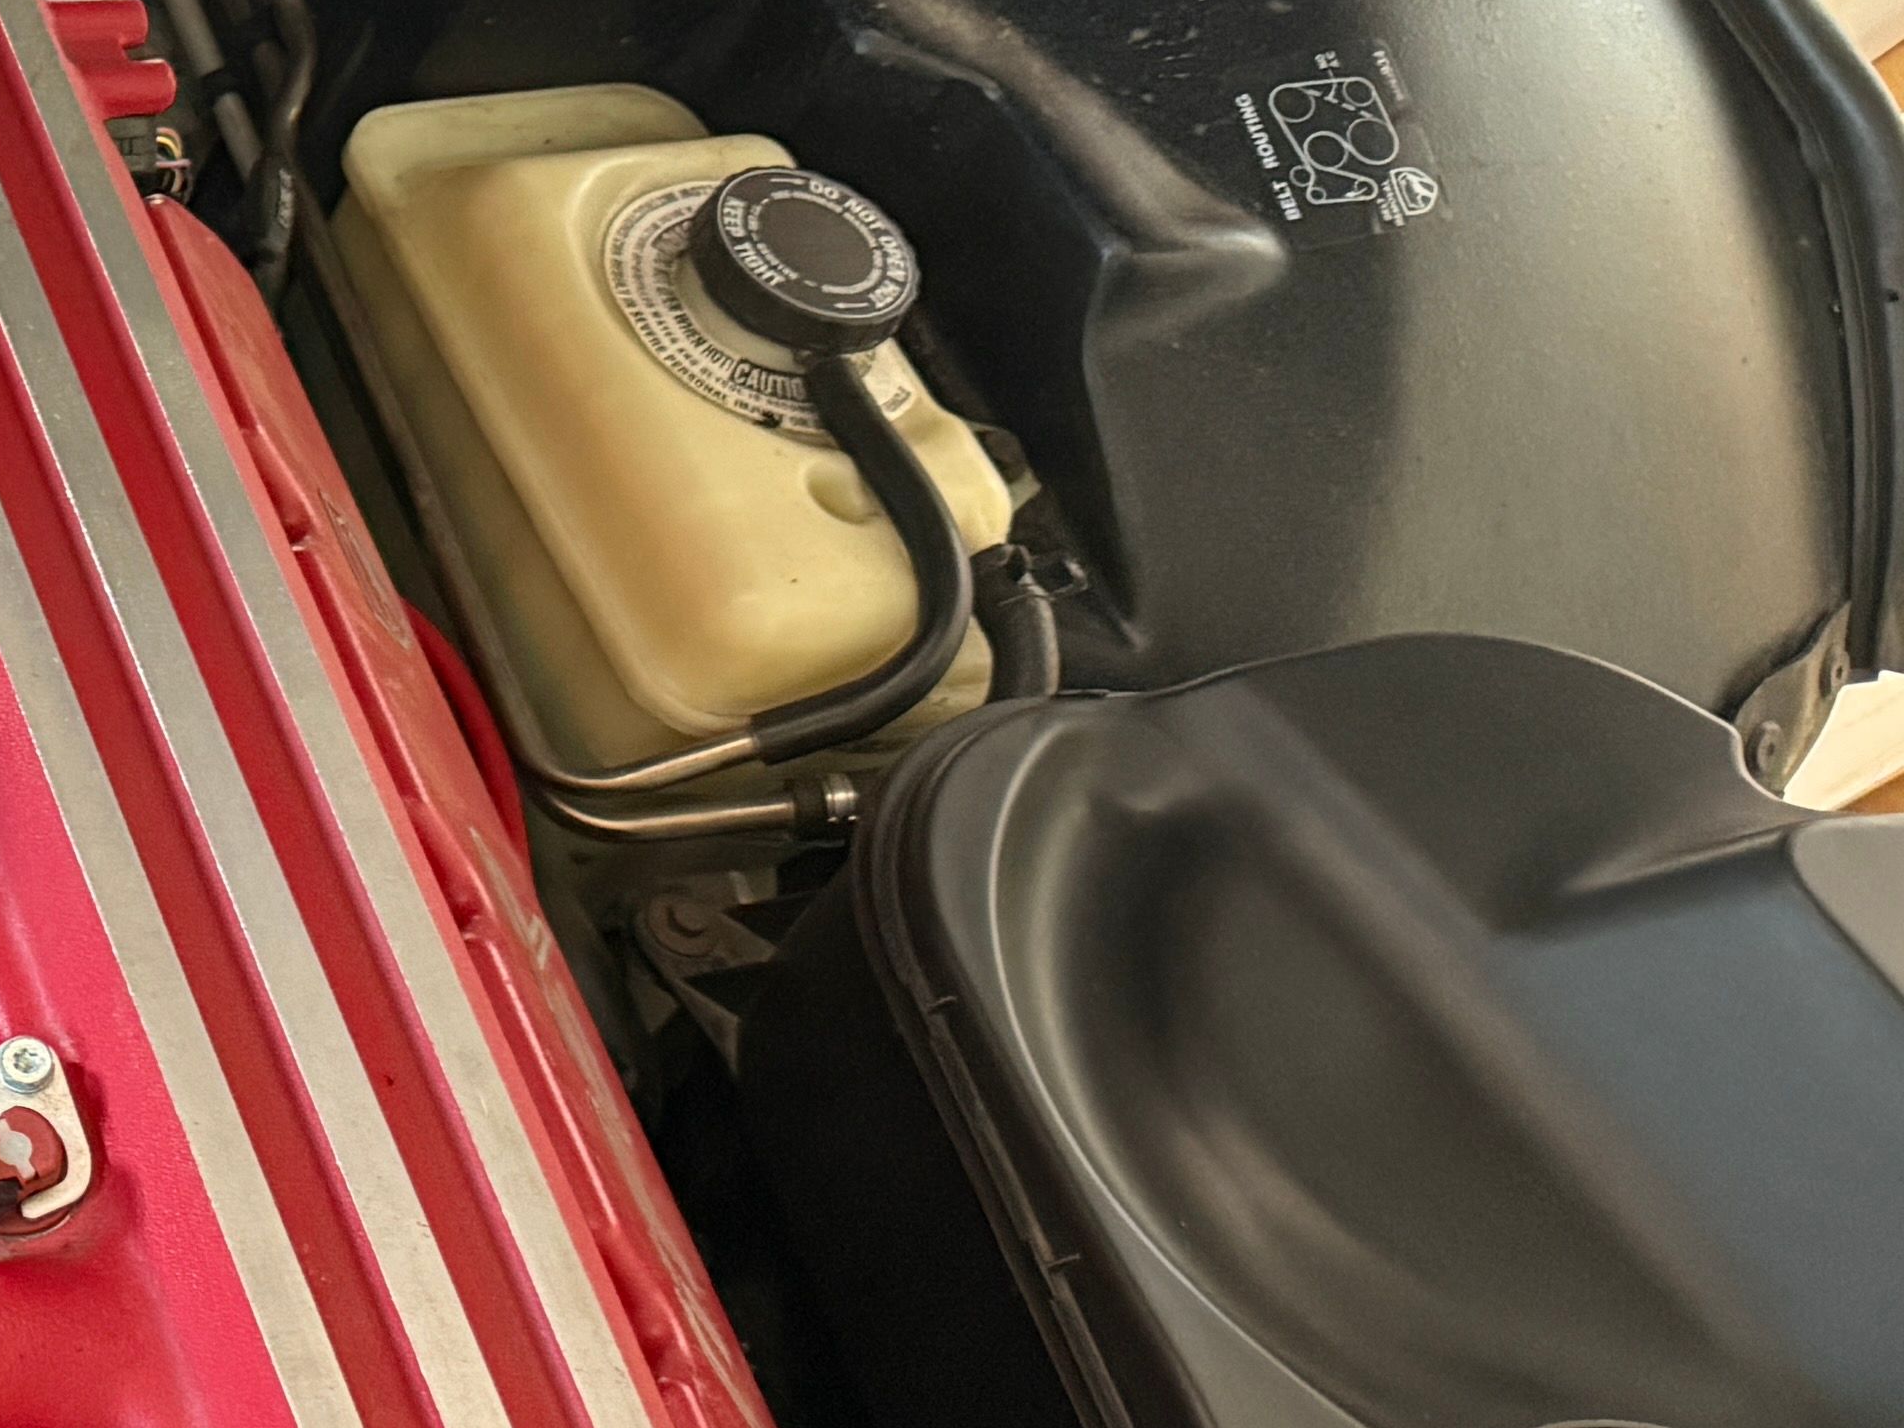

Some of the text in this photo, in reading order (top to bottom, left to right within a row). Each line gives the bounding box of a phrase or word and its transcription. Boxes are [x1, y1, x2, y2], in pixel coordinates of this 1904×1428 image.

[1233, 92, 1303, 221] BELT ROUTING
[723, 196, 786, 286] KEEP TIGHT
[808, 180, 838, 199] DO
[844, 198, 884, 231] NOT
[878, 235, 905, 282] OPEN
[663, 352, 729, 402] PERSONAL
[731, 357, 809, 401] CAUTIO
